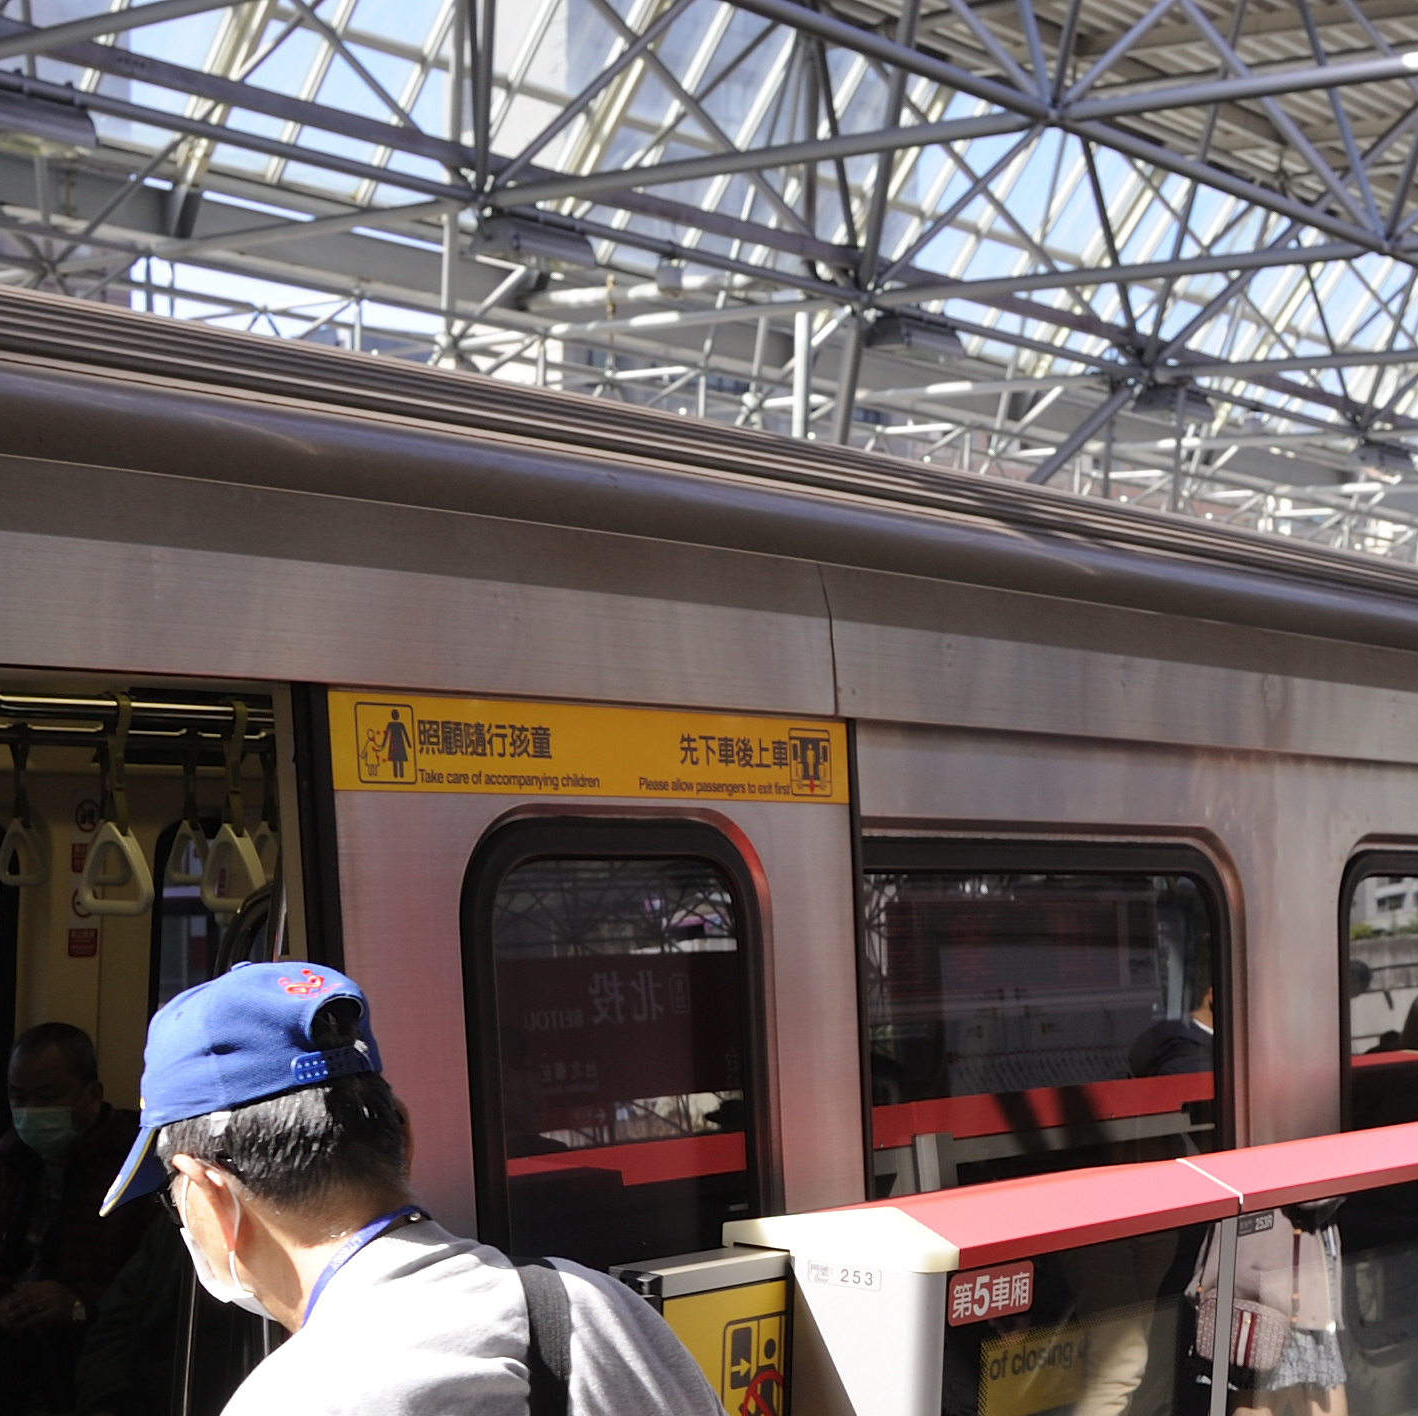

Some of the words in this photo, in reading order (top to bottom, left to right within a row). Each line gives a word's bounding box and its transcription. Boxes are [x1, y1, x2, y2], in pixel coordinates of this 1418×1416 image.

[417, 719, 552, 759] 照顧隨行孩童
[679, 733, 789, 769] 先下車後上車
[418, 769, 444, 785] Take
[446, 773, 470, 786] care
[472, 770, 482, 786] of
[484, 773, 560, 791] accompanying
[561, 774, 600, 789] children
[639, 777, 669, 791] Please
[671, 779, 694, 792] allow
[696, 781, 746, 796] passengers
[747, 782, 757, 794] to
[758, 782, 772, 795] exit
[774, 783, 790, 796] first
[840, 1268, 873, 1286] 253
[952, 1271, 1030, 1318] 第5車廂
[989, 1349, 1008, 1381] of
[1011, 1339, 1073, 1375] closing
